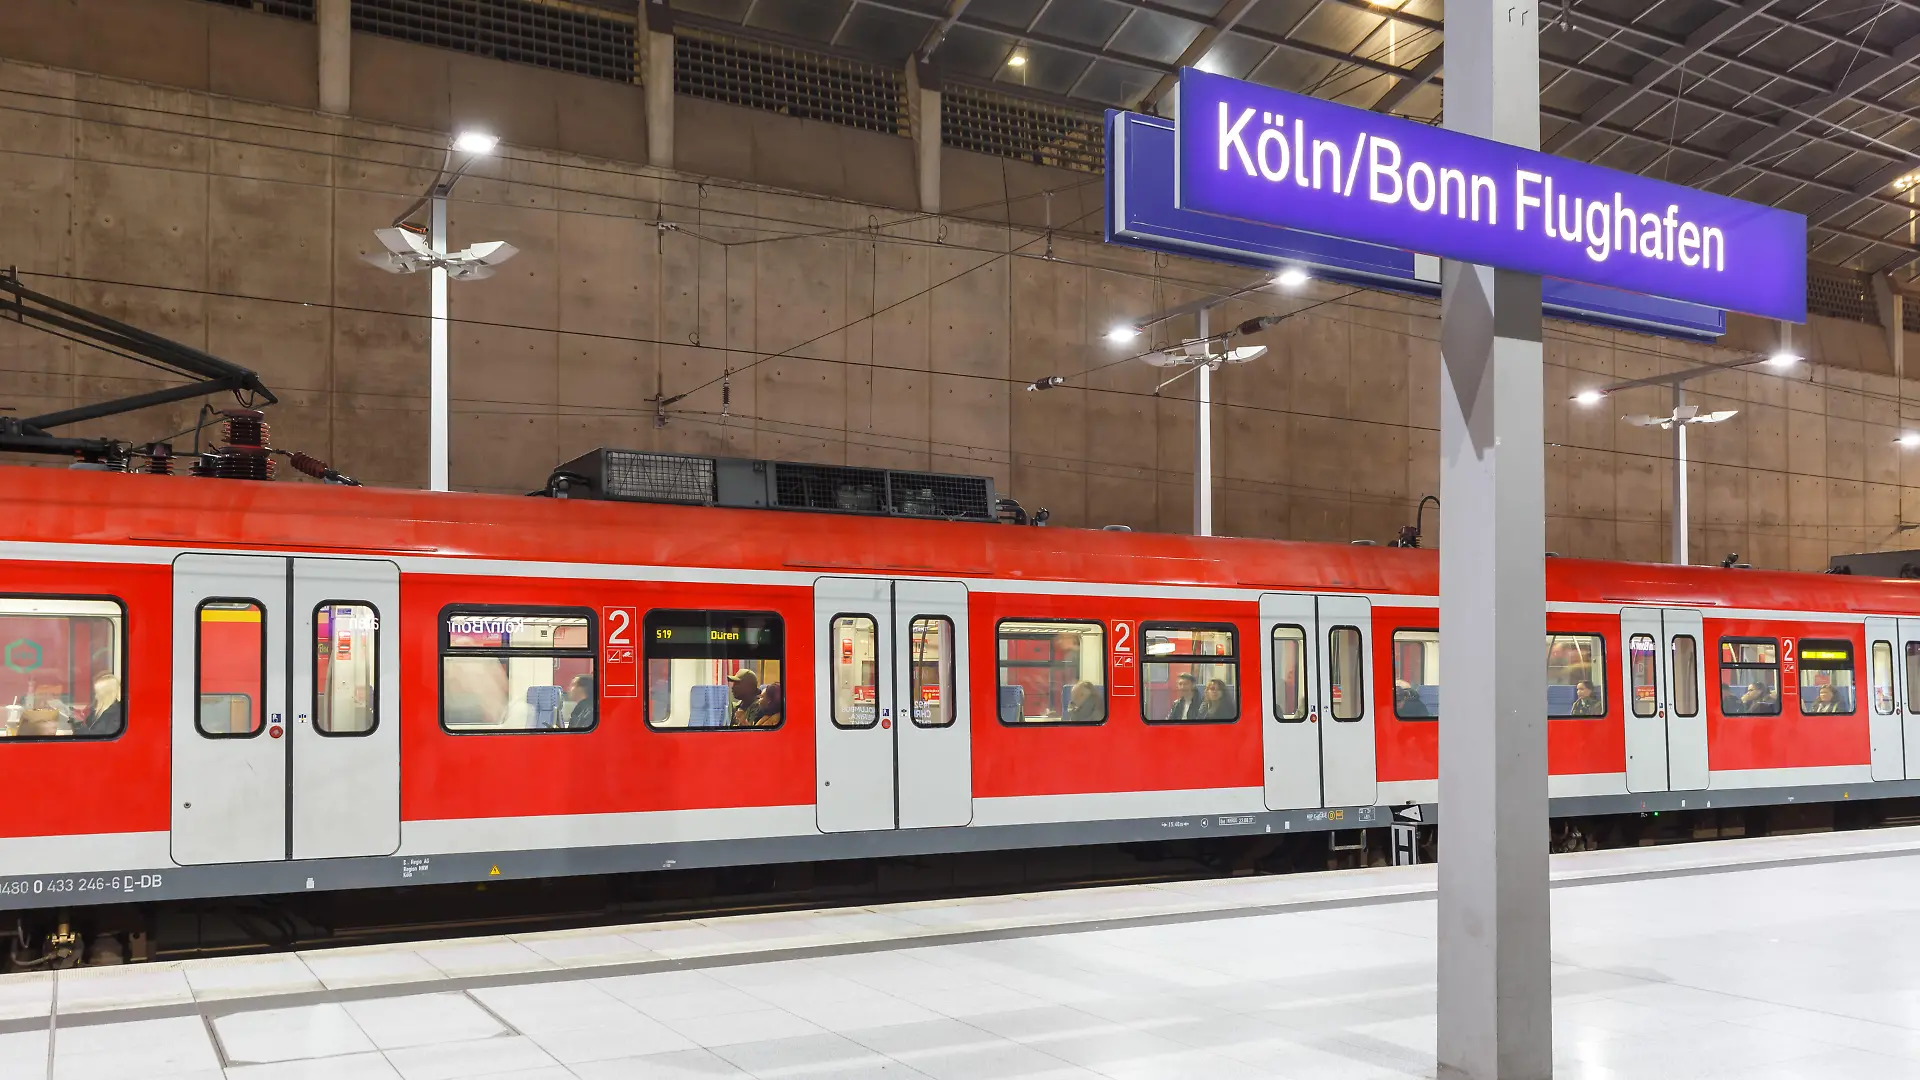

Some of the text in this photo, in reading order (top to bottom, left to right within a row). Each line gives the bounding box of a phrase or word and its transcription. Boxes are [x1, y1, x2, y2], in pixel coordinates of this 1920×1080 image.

[1218, 102, 1724, 272] Köln/Bonn Flughafen
[608, 610, 630, 644] 2
[656, 629, 739, 640] S19 Düren
[1115, 623, 1130, 651] 2
[1783, 639, 1793, 661] 2
[1394, 829, 1412, 866] H
[0, 874, 162, 895] 480 0 433 246-6 D-DB
